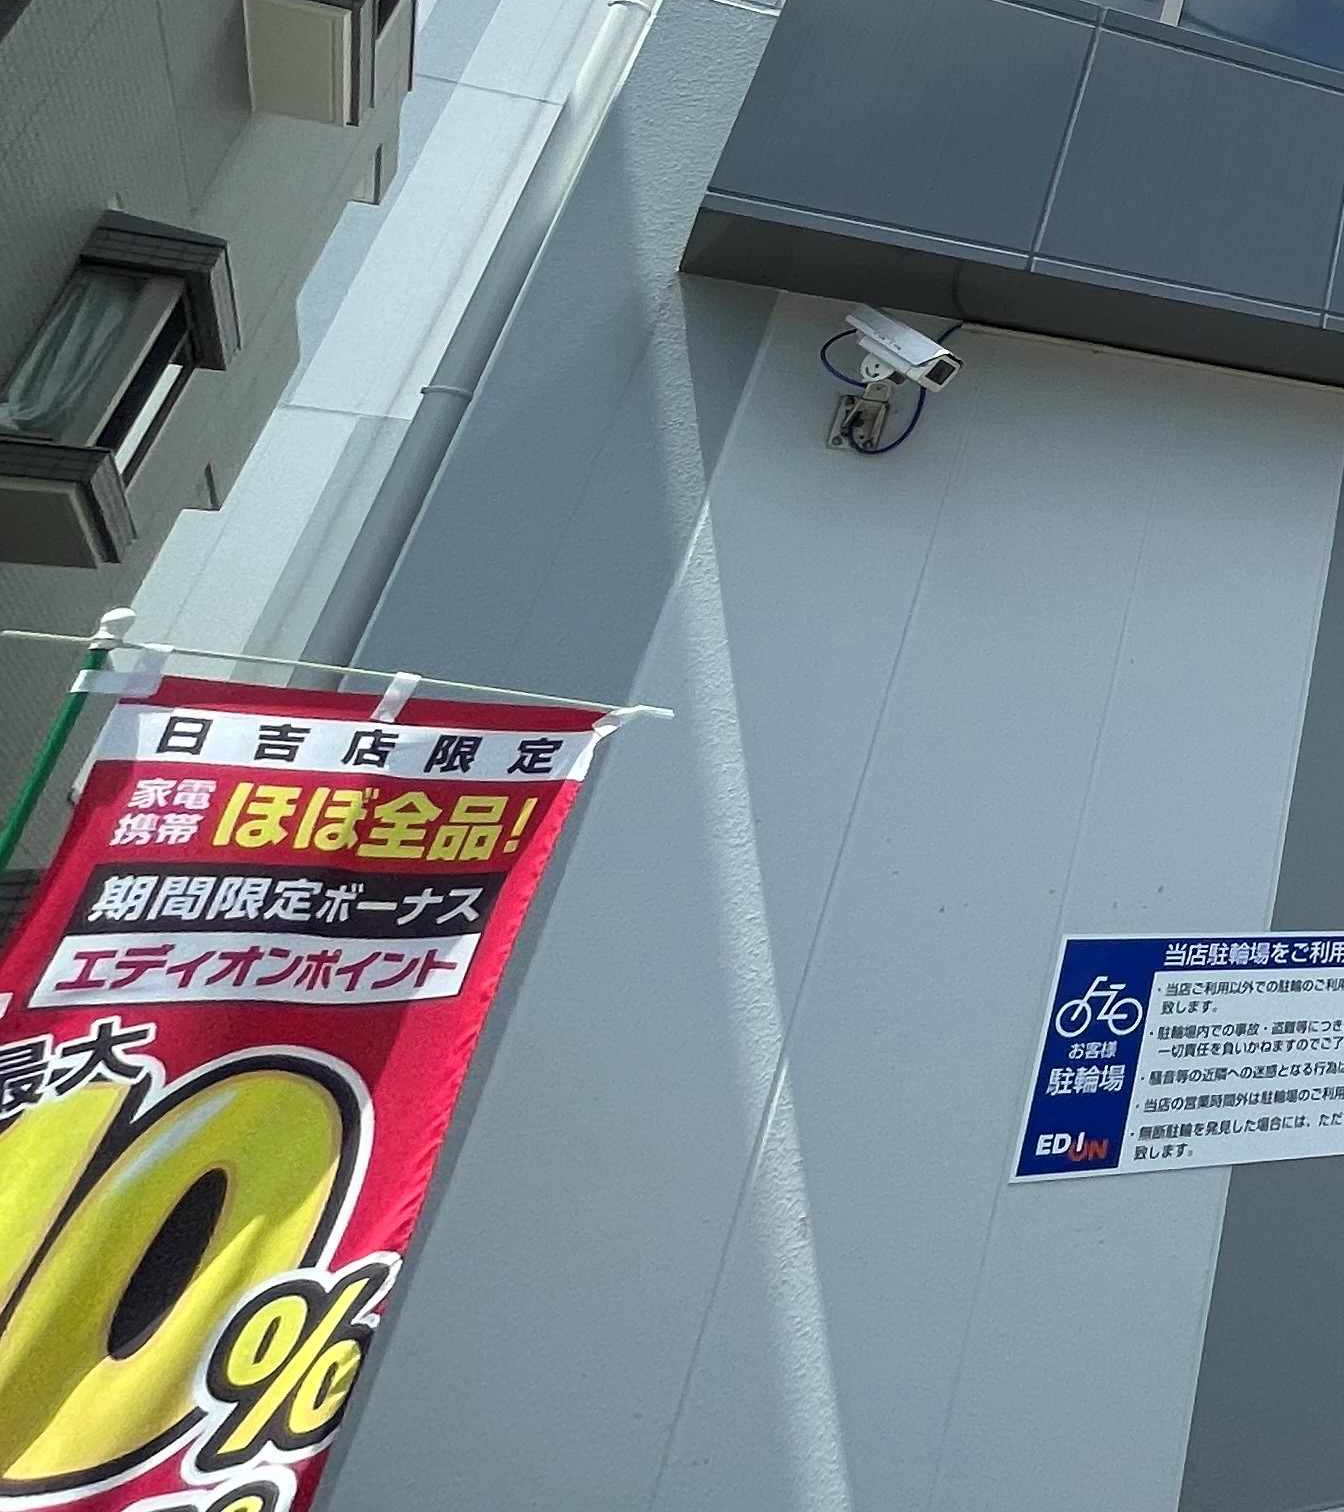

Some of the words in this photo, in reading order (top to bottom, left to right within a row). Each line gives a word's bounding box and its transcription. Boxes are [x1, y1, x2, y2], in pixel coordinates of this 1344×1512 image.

[155, 715, 563, 775] 日吉店限定
[128, 777, 217, 810] 家電
[109, 812, 204, 847] 携帯
[212, 781, 534, 862] ほぼ全品!
[87, 874, 487, 926] 期間限定ボーナス
[66, 944, 459, 993] エディオンポイント
[1068, 1040, 1118, 1059] お客様
[1046, 1064, 1126, 1096] 駐輪場
